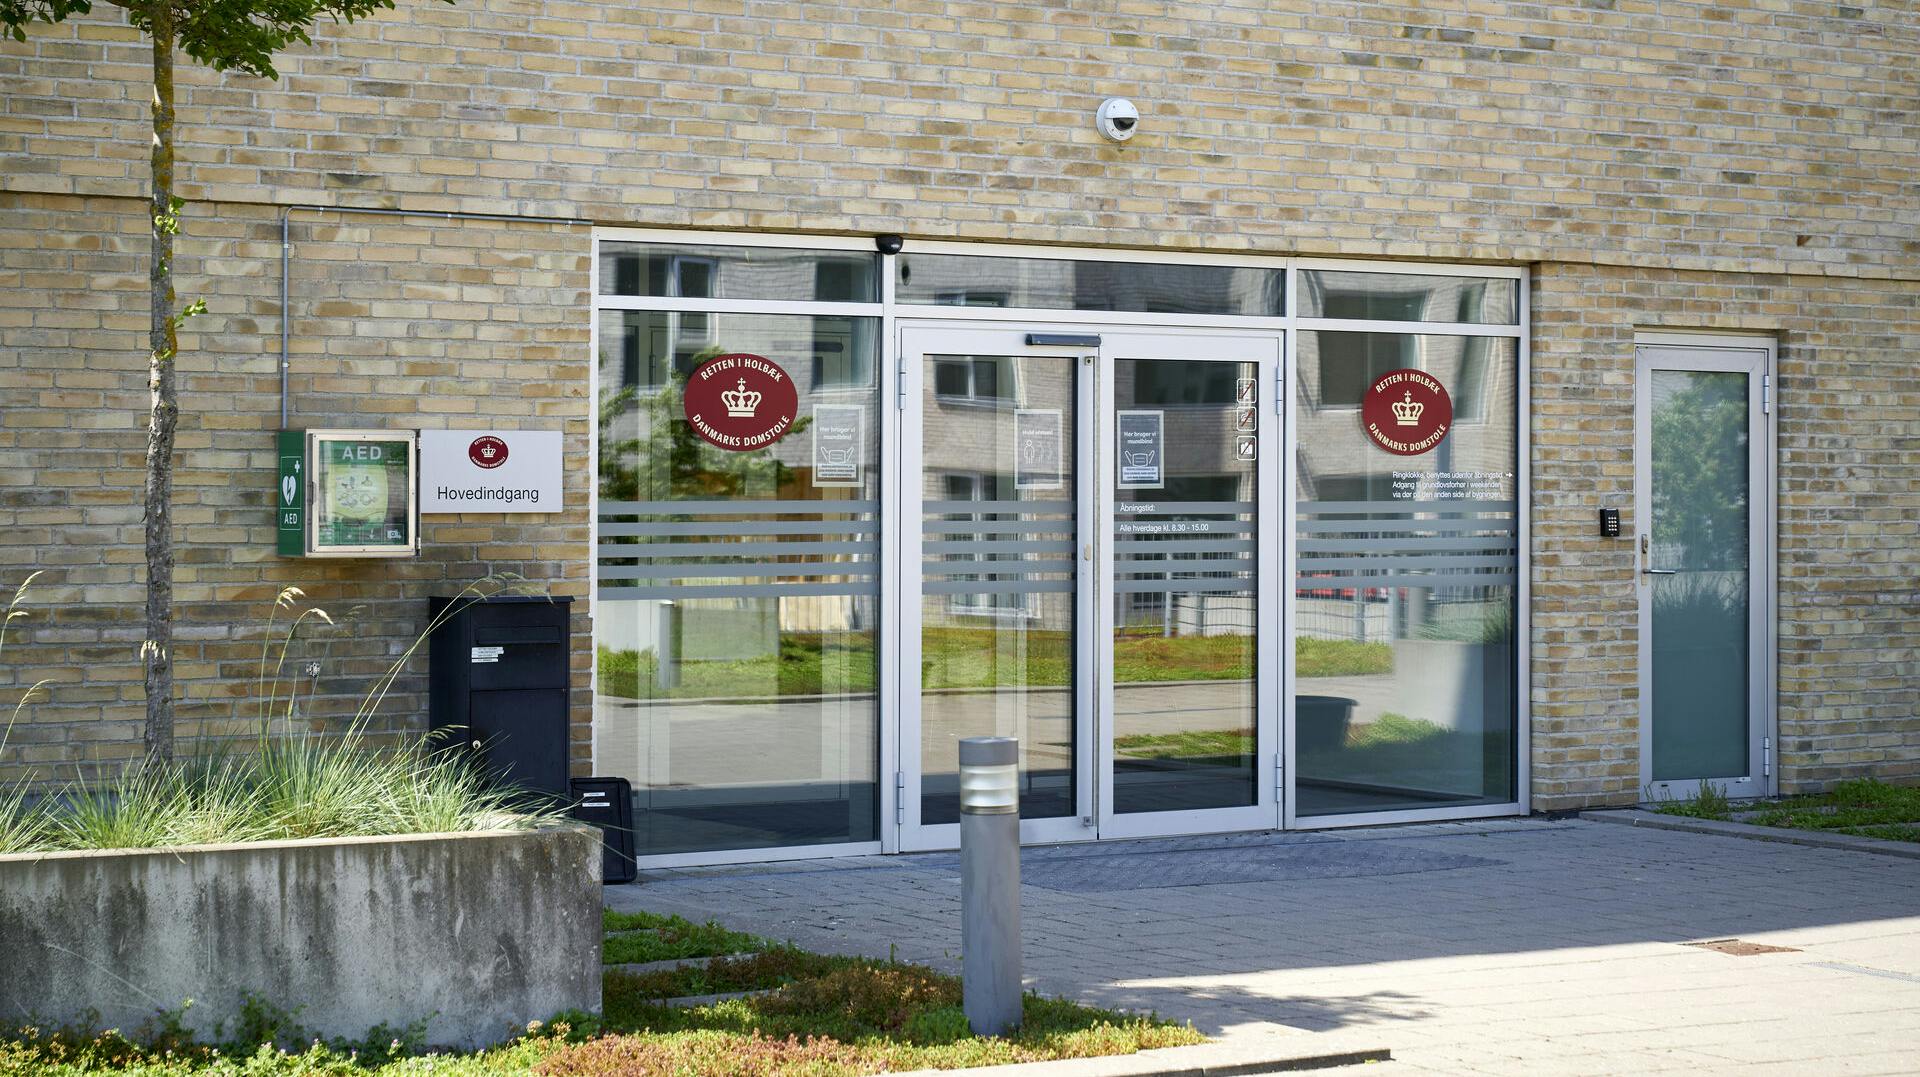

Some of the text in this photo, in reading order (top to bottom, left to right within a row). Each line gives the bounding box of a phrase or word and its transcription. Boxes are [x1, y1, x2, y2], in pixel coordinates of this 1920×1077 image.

[700, 357, 783, 382] RETTEN I HOLBÆK
[1375, 373, 1440, 395] RETTEN I HOLBÆK
[692, 413, 790, 446] DANMARKS DOMSTOLE
[1369, 422, 1446, 451] DANMARKS DOMSTOLE
[342, 445, 382, 460] AED
[1451, 471, 1473, 479] udenfor
[1392, 481, 1415, 490] Adgang
[437, 486, 539, 504] Hovedindgang
[1119, 502, 1156, 513] Åbningstid:
[284, 513, 298, 525] AED
[1119, 523, 1132, 532] Alle
[1132, 523, 1162, 533] hverdage
[1162, 523, 1171, 532] kl.
[1171, 523, 1186, 532] 8.30
[1191, 523, 1209, 531] 15.00
